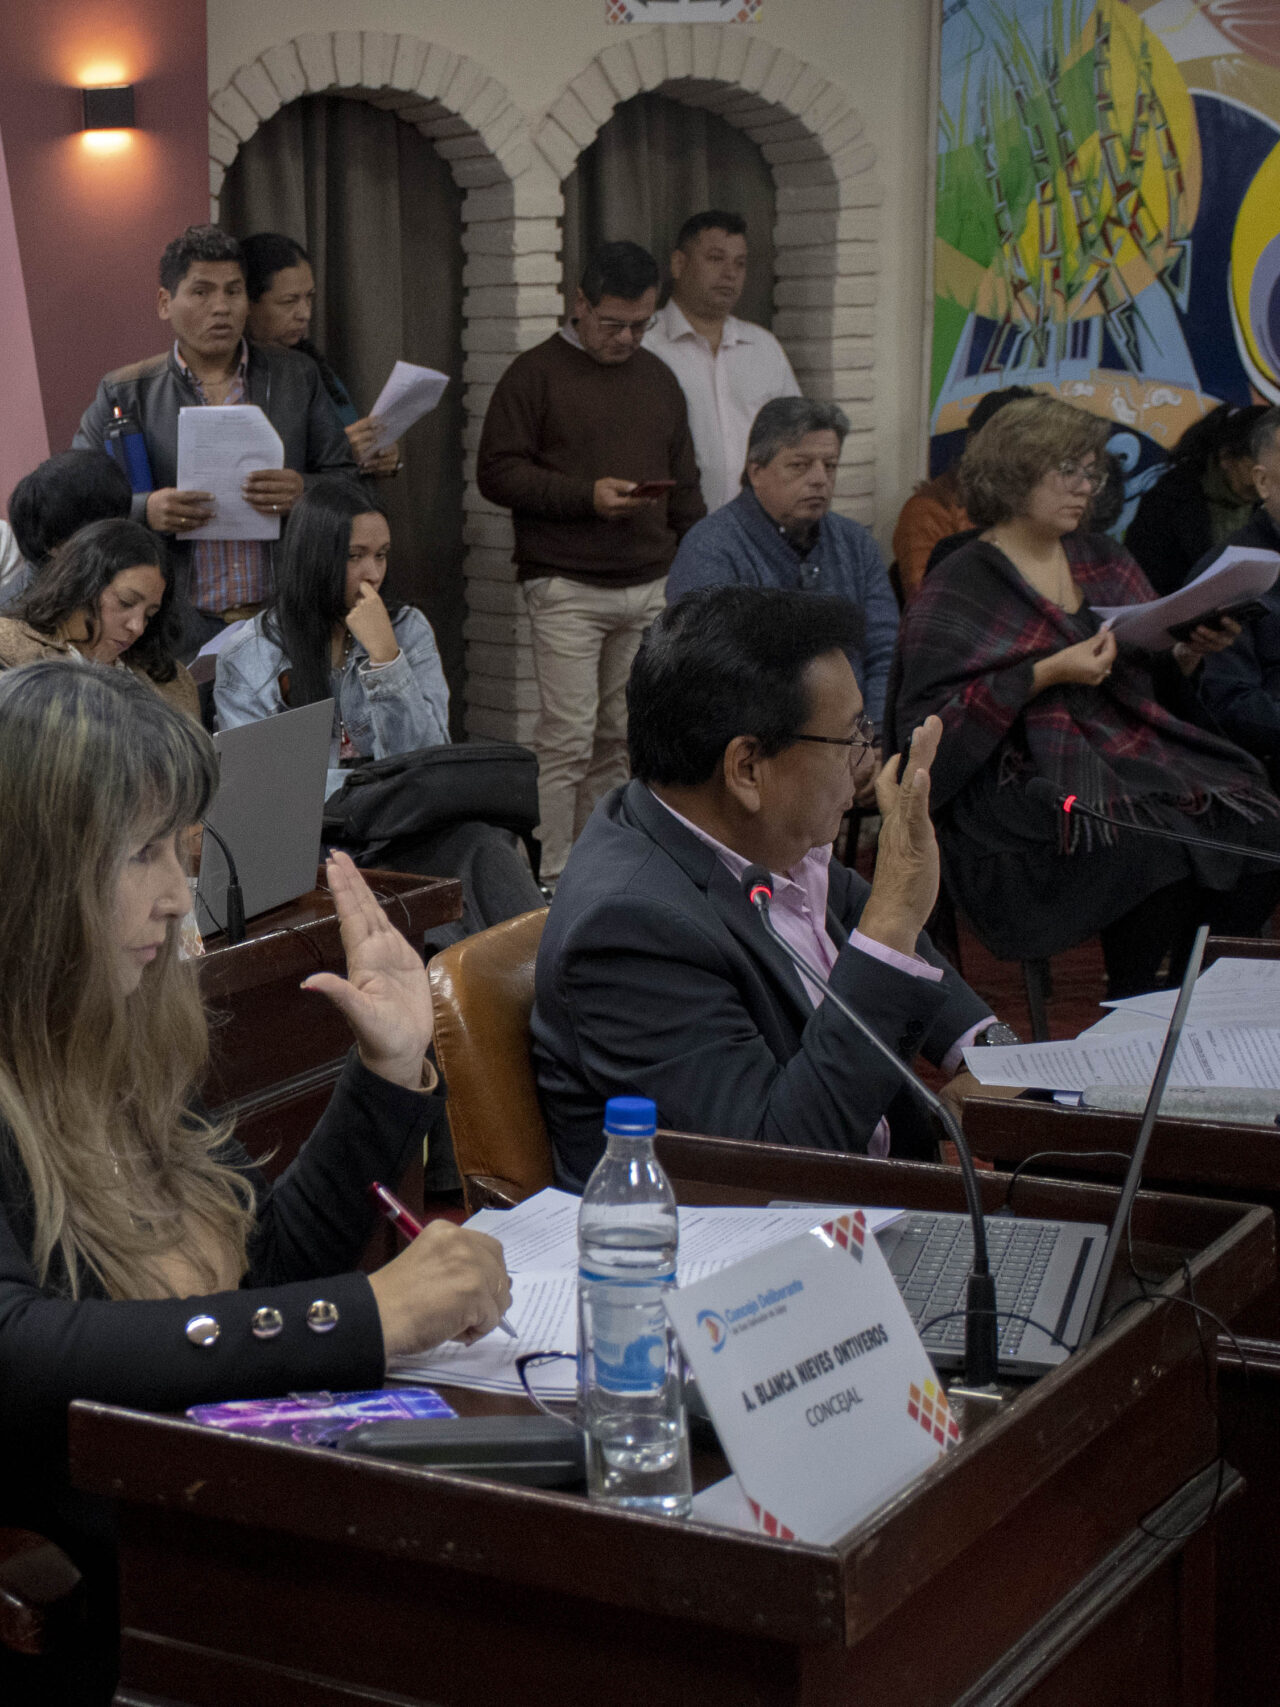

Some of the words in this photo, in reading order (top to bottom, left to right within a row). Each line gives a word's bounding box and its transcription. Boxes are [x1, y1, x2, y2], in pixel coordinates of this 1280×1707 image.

[741, 1390, 757, 1413] A.
[754, 1369, 798, 1406] BLANCA
[795, 1350, 835, 1385] NIEVES
[833, 1323, 889, 1366] ONTIVEROS
[805, 1386, 864, 1427] CONCEJAL
